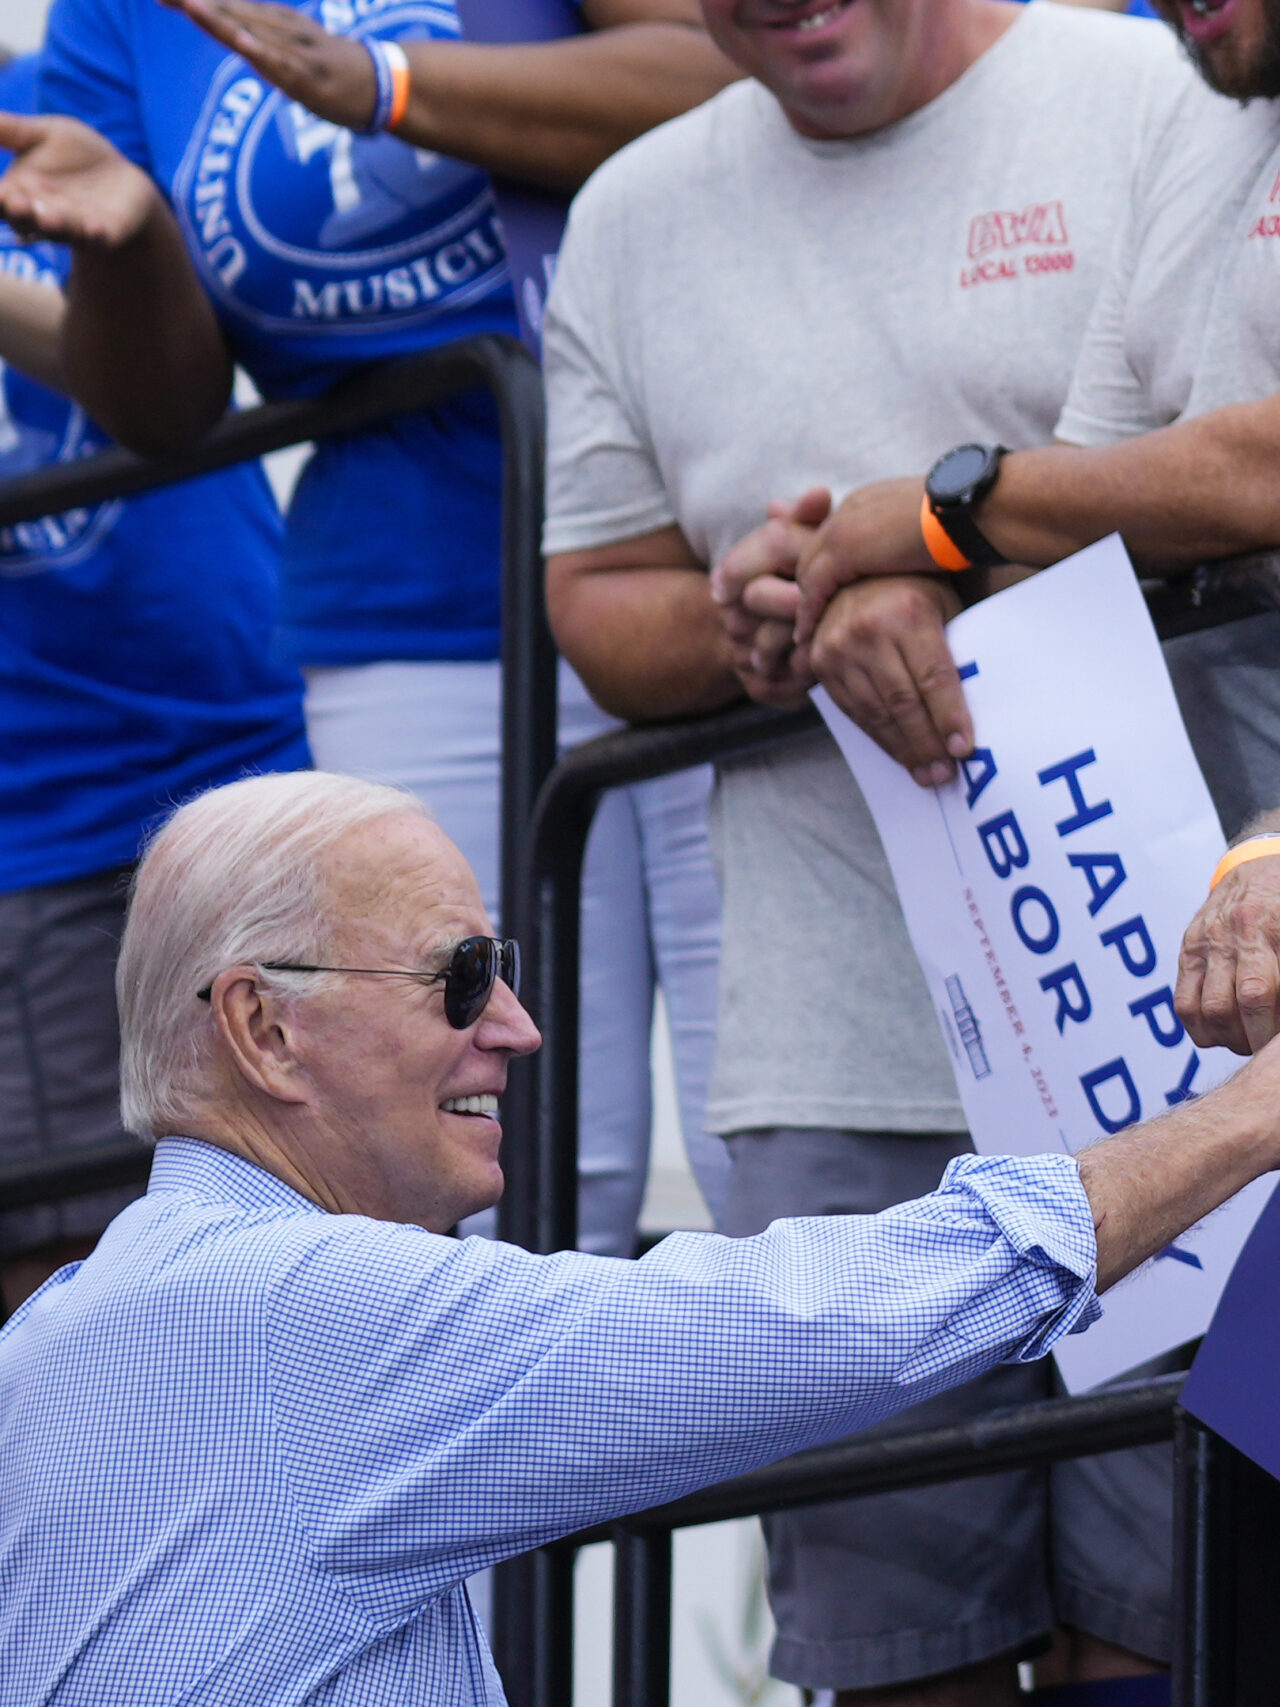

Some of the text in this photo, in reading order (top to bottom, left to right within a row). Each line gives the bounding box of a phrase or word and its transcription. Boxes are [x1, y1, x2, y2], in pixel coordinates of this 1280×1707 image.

[195, 76, 263, 288] UNITED
[291, 216, 503, 318] MUSICI
[1037, 746, 1201, 1106] HAPPY
